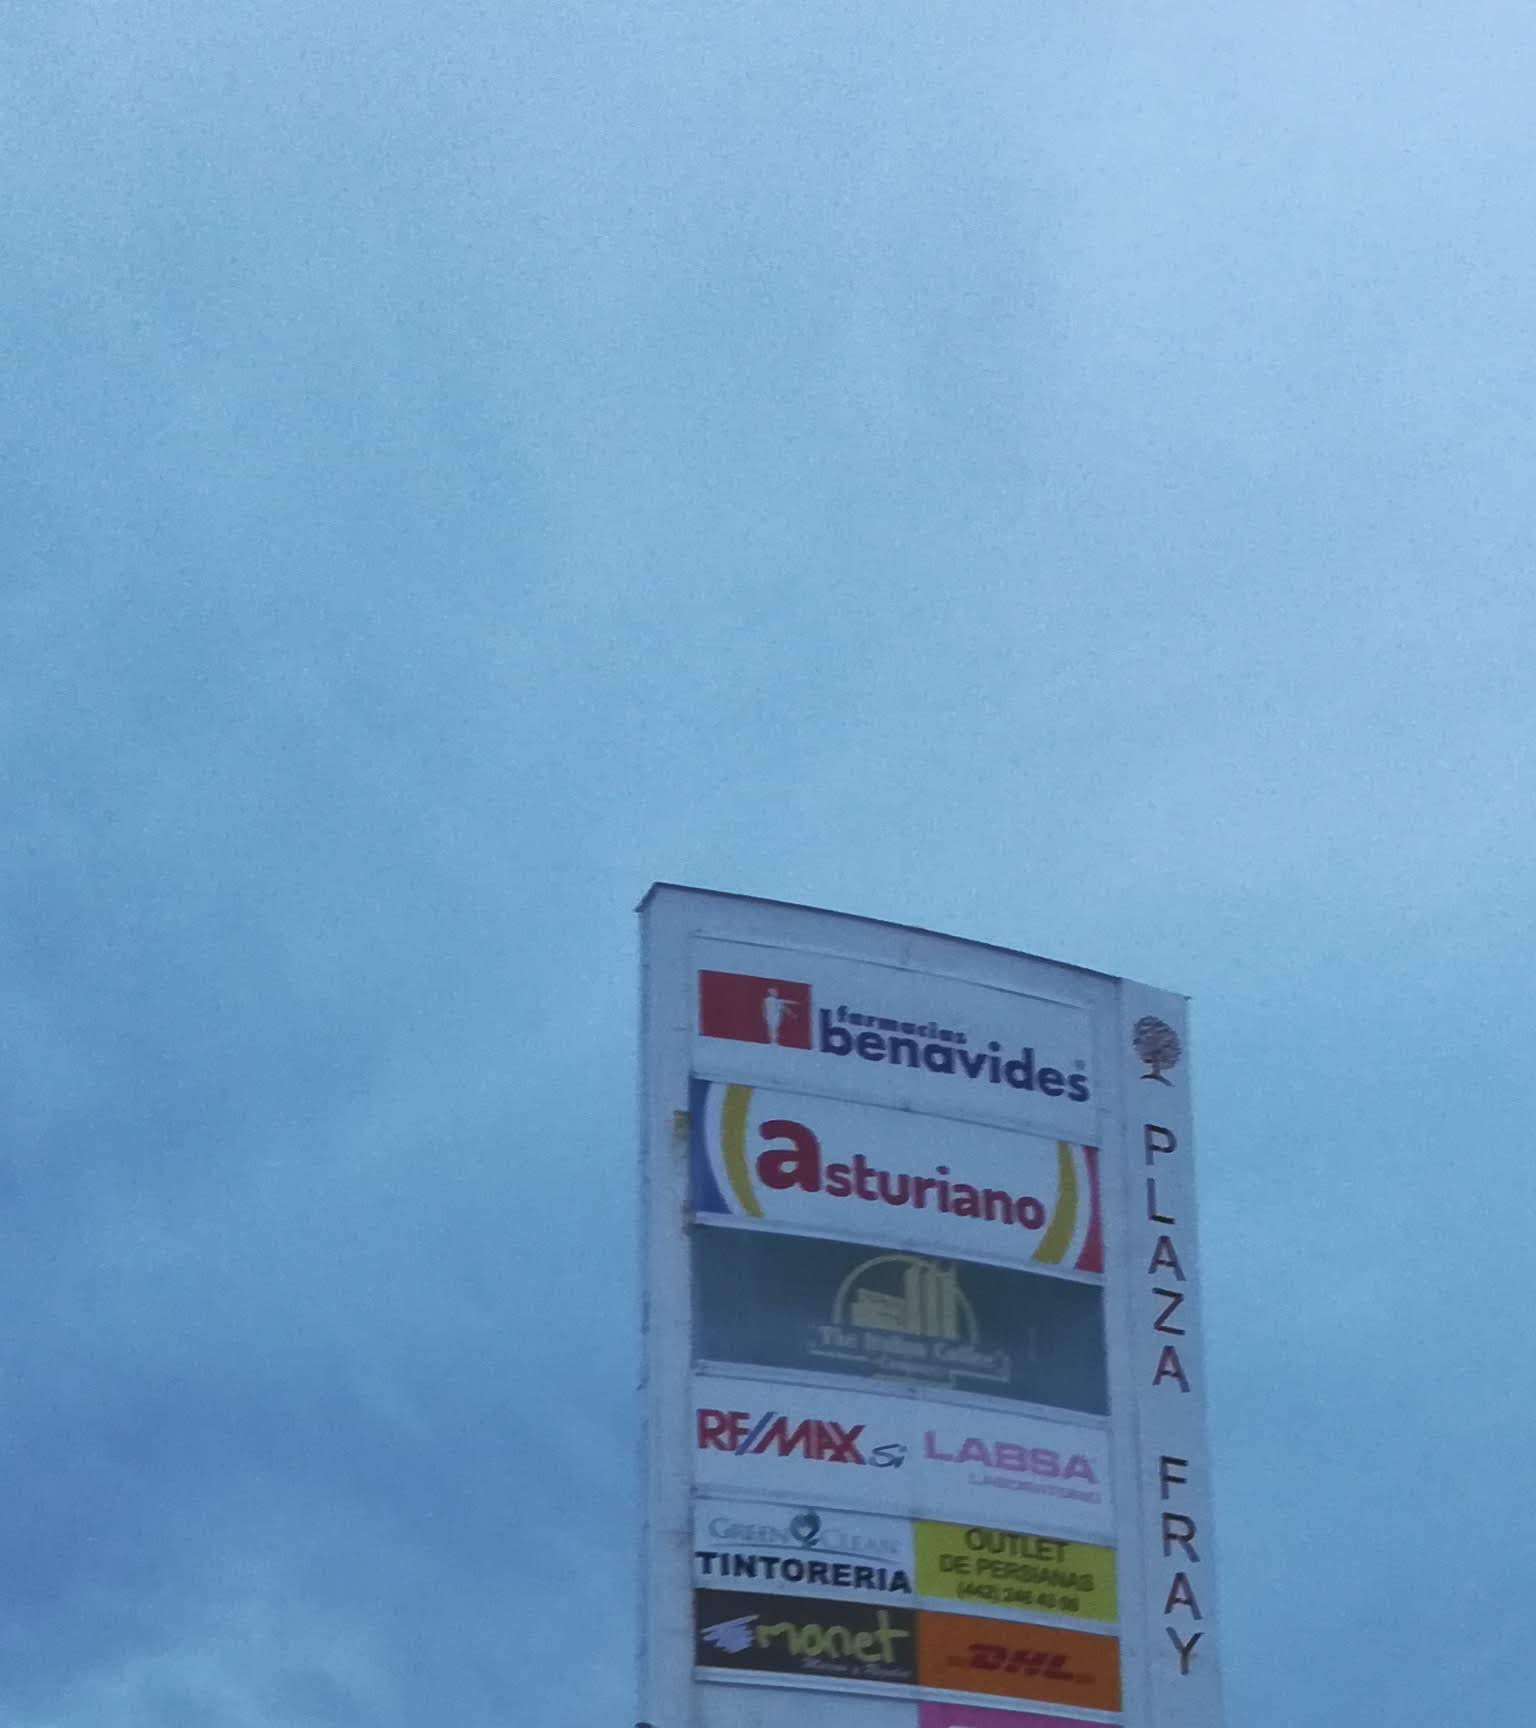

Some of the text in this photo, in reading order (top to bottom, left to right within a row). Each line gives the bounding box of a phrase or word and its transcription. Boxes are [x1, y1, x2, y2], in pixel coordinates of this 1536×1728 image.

[819, 1008, 1091, 1102] benavides
[755, 1117, 1046, 1230] asturiano
[1144, 1122, 1191, 1393] PLAZA
[696, 1408, 866, 1466] RE/MAX
[924, 1431, 1100, 1485] LABSA
[695, 1550, 912, 1594] TINTORERIA
[938, 1553, 971, 1575] DE
[965, 1527, 1069, 1563] OUTLET
[1159, 1456, 1204, 1675] FRAY
[756, 1609, 910, 1664] monet
[967, 1642, 1075, 1681] DHL
